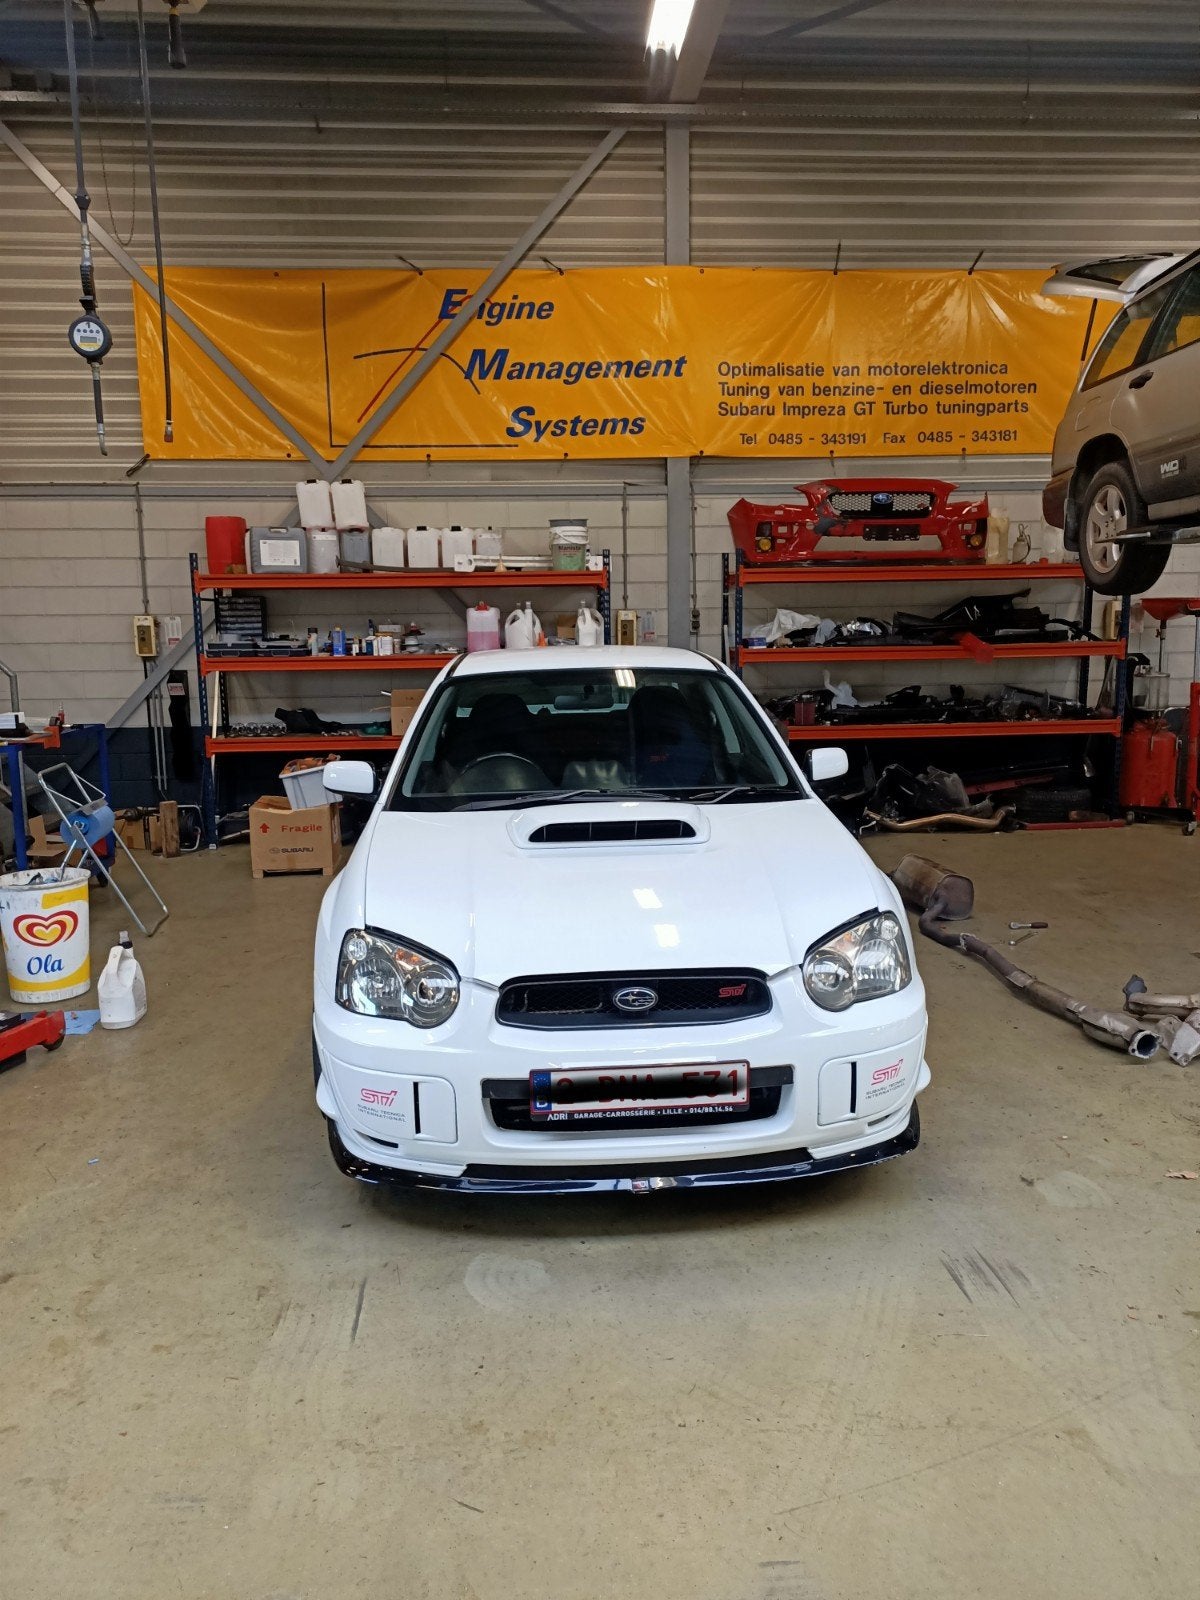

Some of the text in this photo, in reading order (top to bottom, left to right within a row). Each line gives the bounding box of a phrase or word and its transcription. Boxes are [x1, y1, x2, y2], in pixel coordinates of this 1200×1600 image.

[464, 349, 688, 385] Management
[718, 361, 1008, 379] Optimalisatie van motorelektronica
[718, 380, 1037, 399] Tuning van benzine- en dieselmotoren
[718, 400, 1029, 419] Subaru Impreza GT Turbo tuningparts
[506, 406, 646, 442] Systems
[740, 433, 757, 445] Tel
[768, 433, 802, 445] 0485
[821, 433, 867, 445] 343191
[883, 432, 905, 444] Fax
[917, 431, 953, 443] 0485
[971, 430, 1018, 442] 343181
[280, 824, 323, 833] Fragile
[27, 954, 64, 975] Ola
[547, 1113, 568, 1121] ADRI
[574, 1108, 655, 1119] GARAGE-CARROSSERIE
[662, 1107, 682, 1115] LILLE
